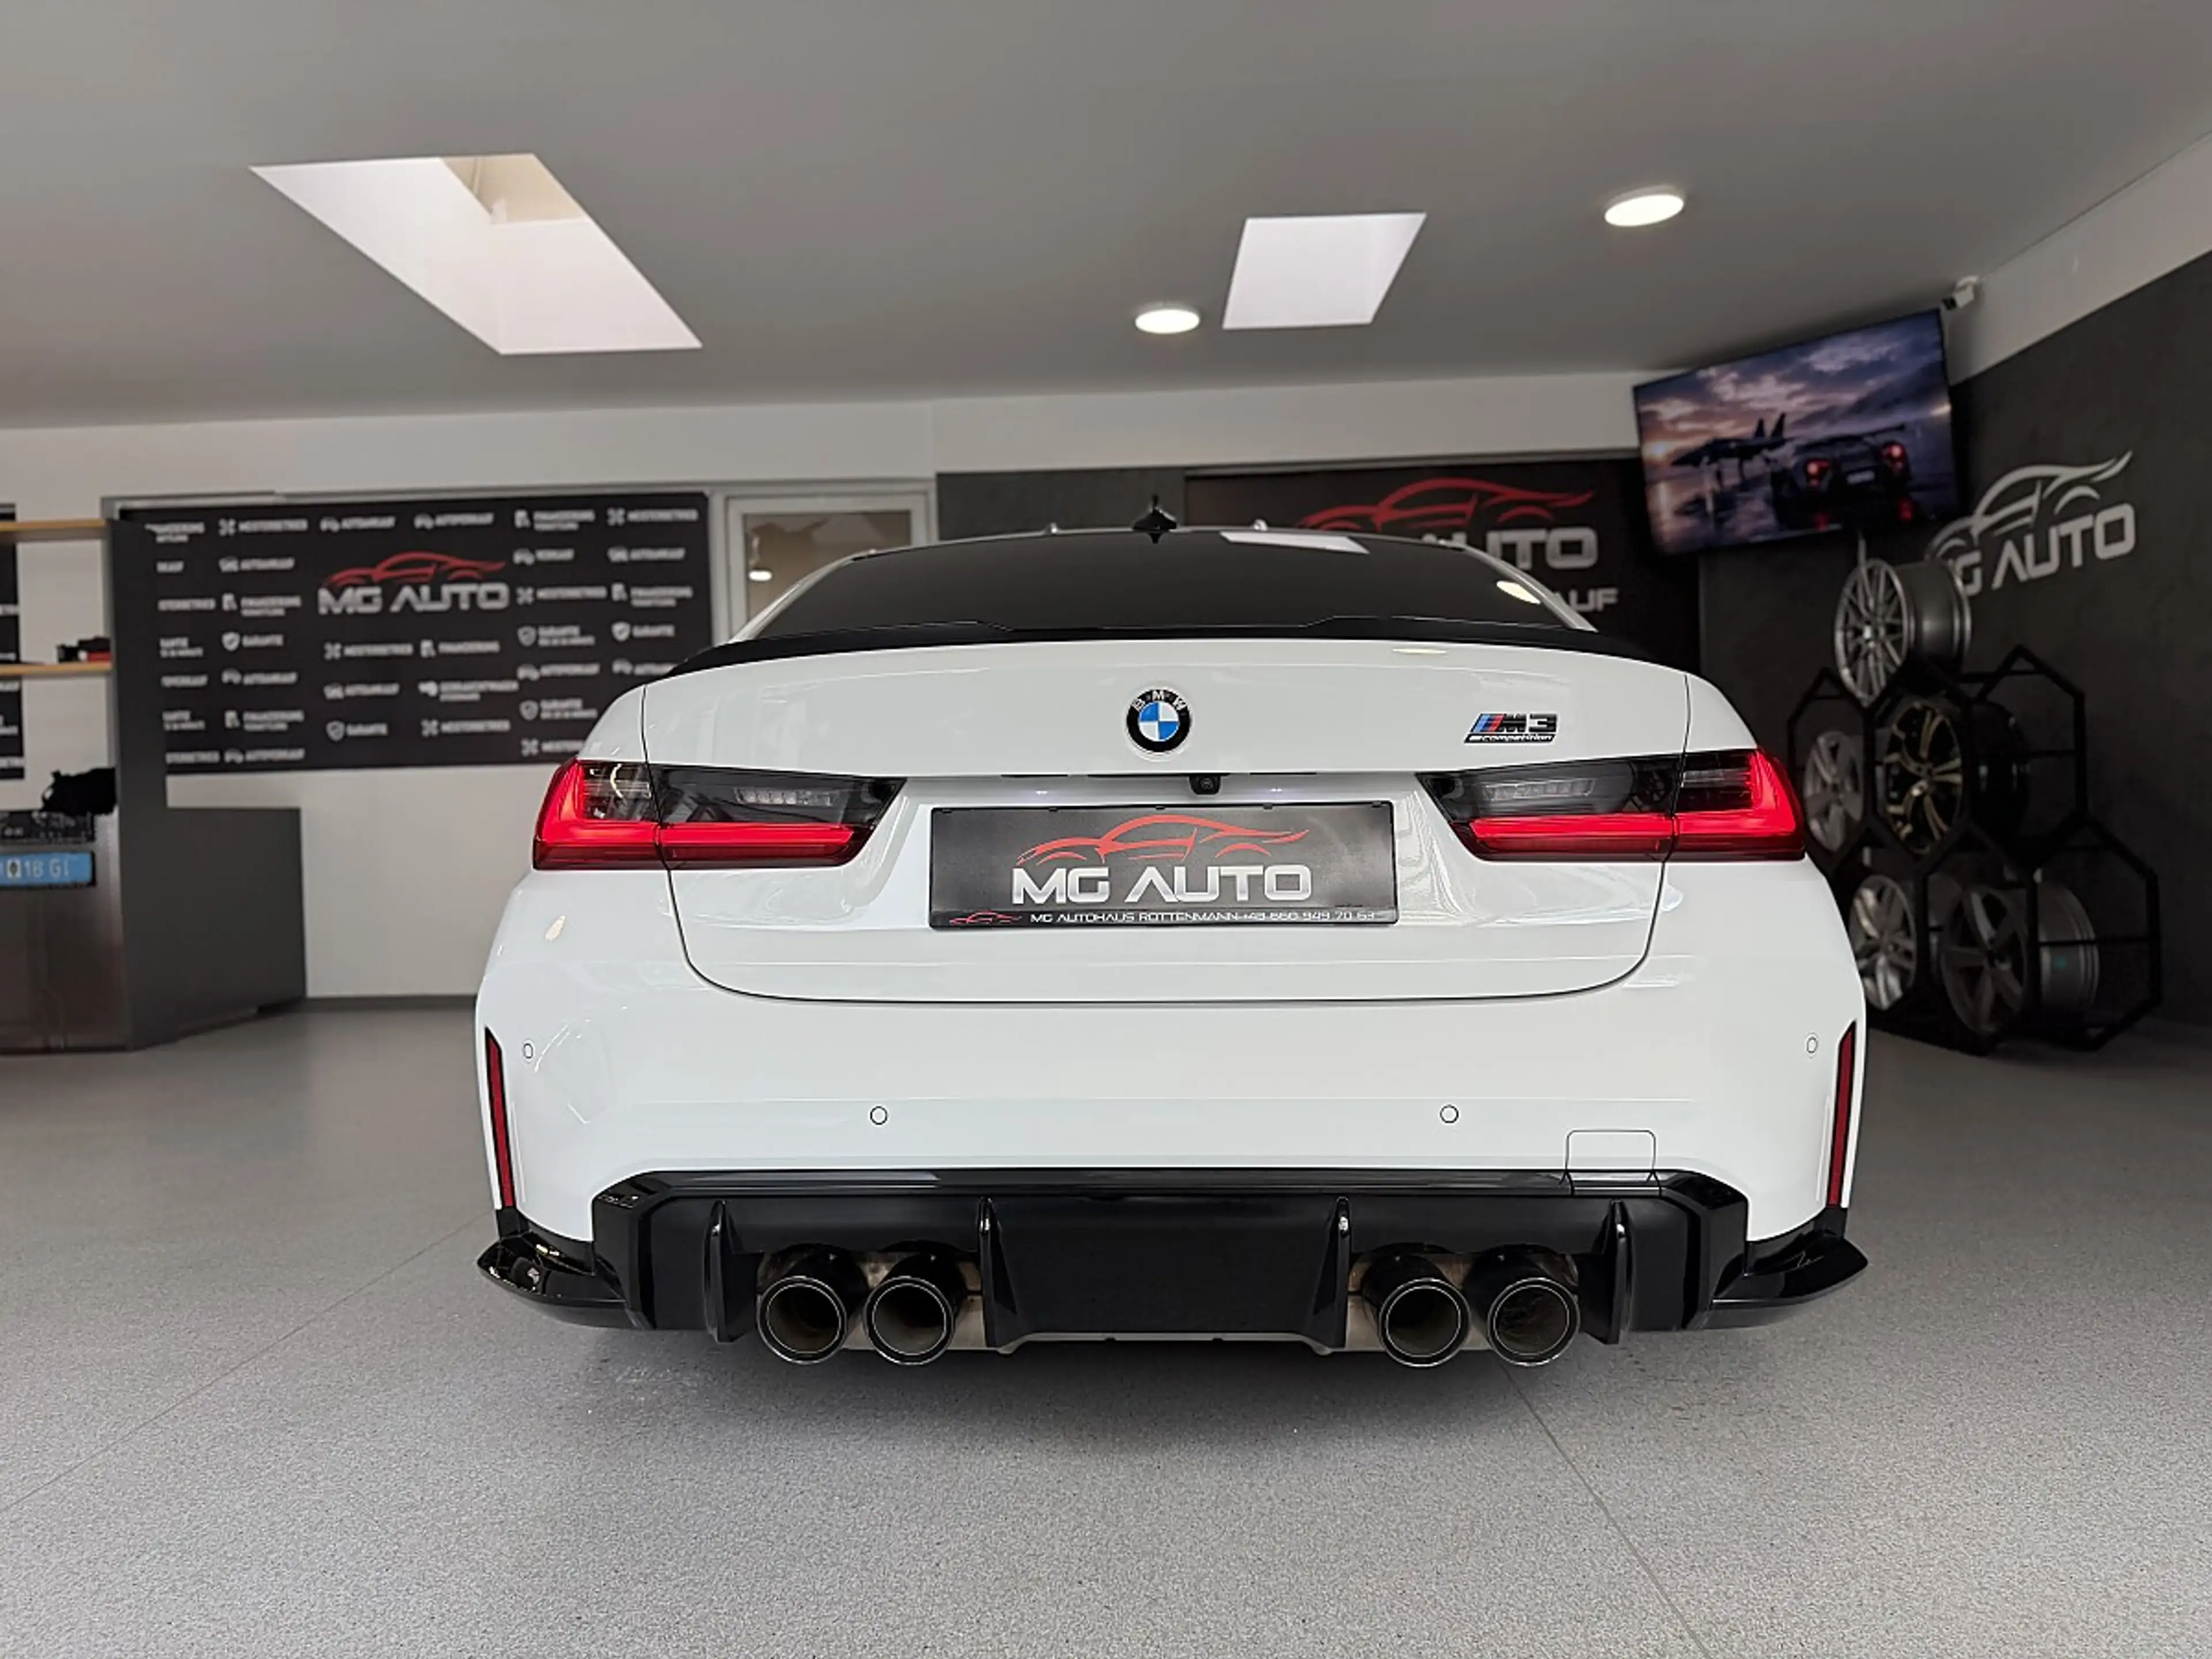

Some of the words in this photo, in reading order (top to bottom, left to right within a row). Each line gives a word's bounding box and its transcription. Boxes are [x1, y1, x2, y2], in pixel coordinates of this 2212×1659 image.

[1422, 527, 1599, 569] TO
[1947, 550, 1982, 596] G
[1991, 503, 2135, 591] AUTO
[317, 585, 382, 615] MG
[389, 582, 510, 613] AUTO
[1131, 690, 1187, 712] BMW
[1492, 713, 1558, 733] M3
[1012, 868, 1110, 904] MG
[1124, 864, 1312, 903] AUTO
[1030, 913, 1053, 923] MG
[1056, 912, 1135, 922] AUTOHAUS
[1138, 911, 1238, 922] ROTTENMANN
[1334, 911, 1353, 921] 70
